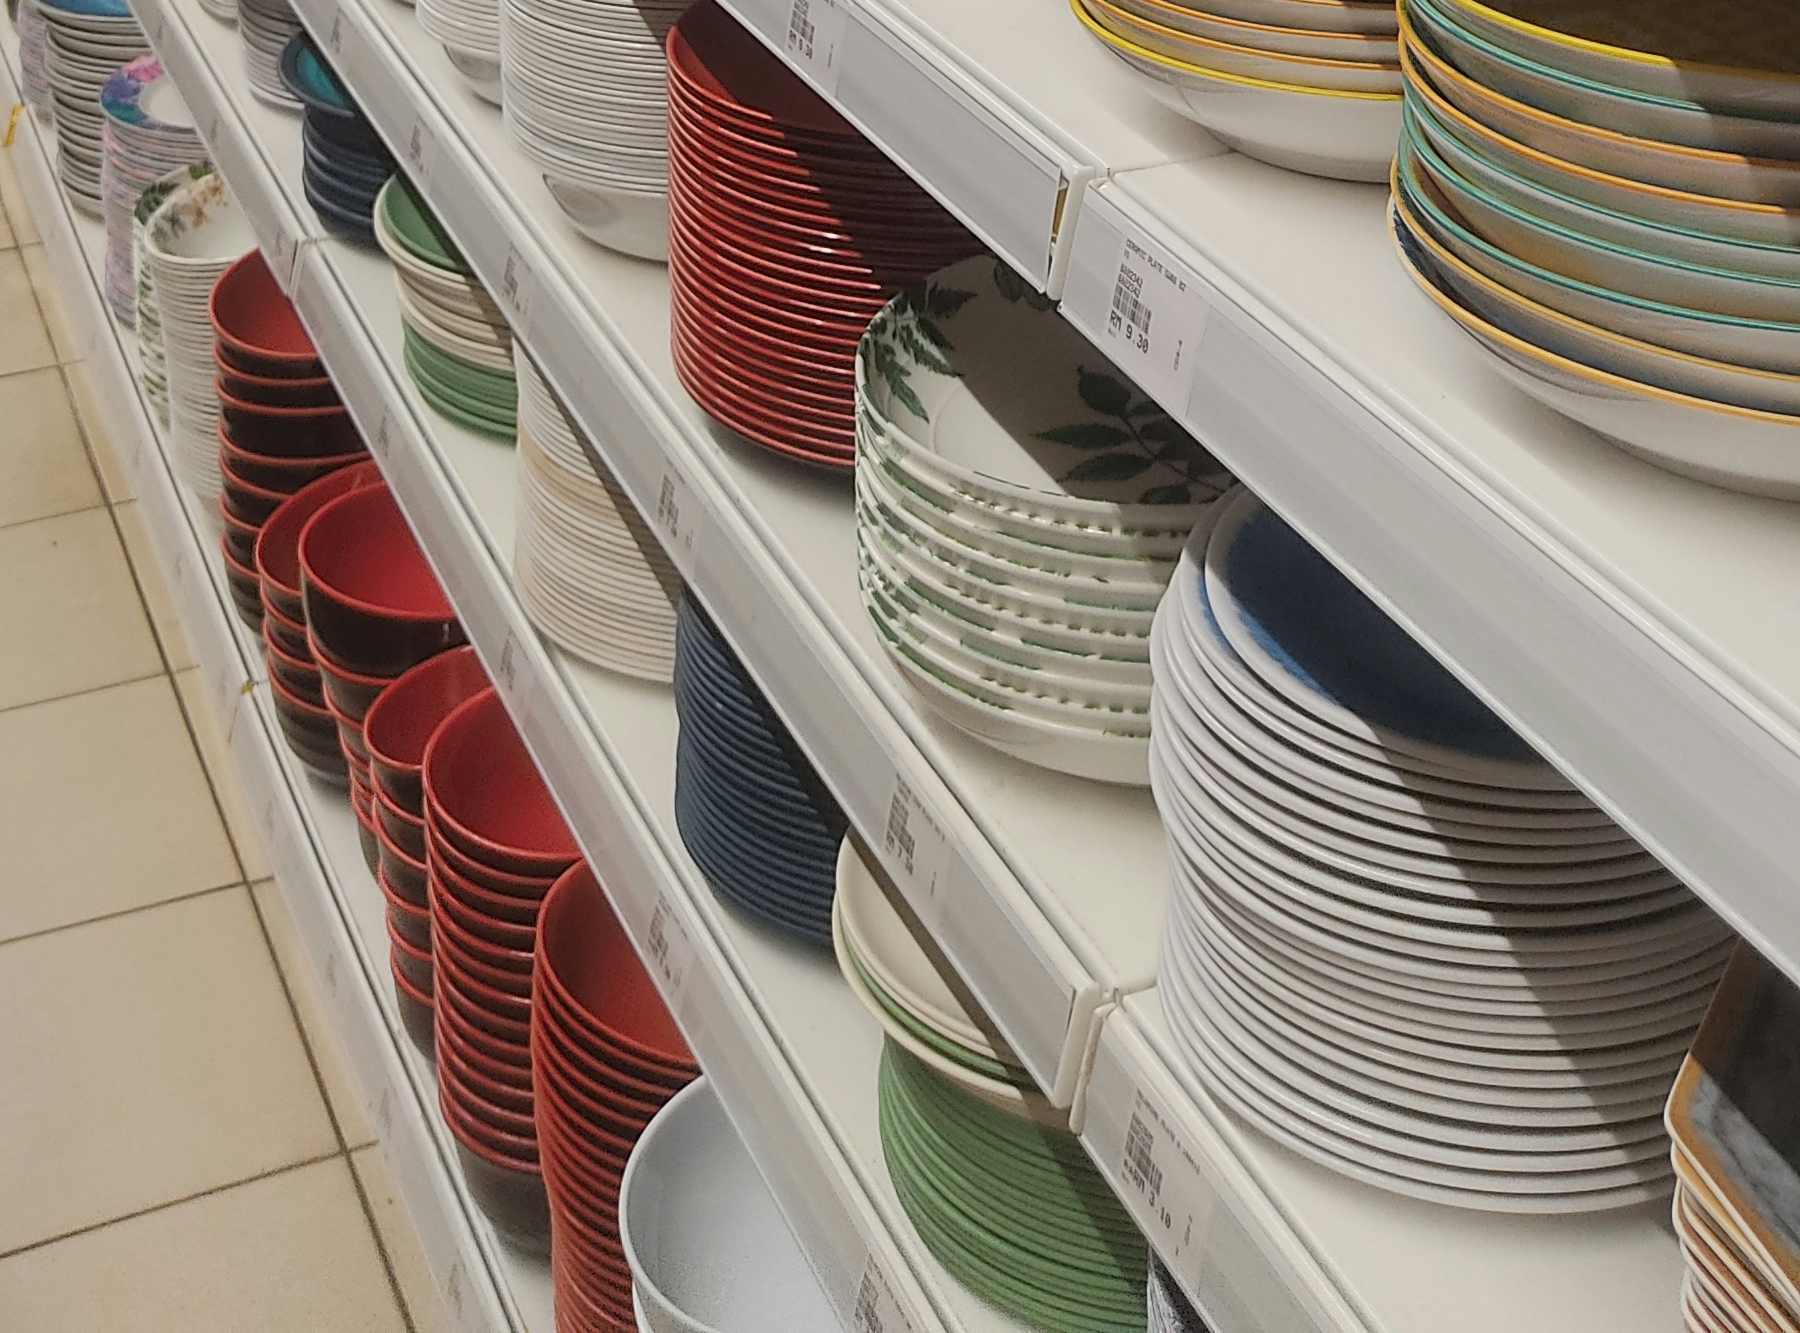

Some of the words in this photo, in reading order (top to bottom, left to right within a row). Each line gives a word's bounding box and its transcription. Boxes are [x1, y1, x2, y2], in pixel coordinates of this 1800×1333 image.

[1109, 309, 1123, 332] RM
[1125, 323, 1149, 354] 9.30
[1148, 1189, 1172, 1230] 3.10
